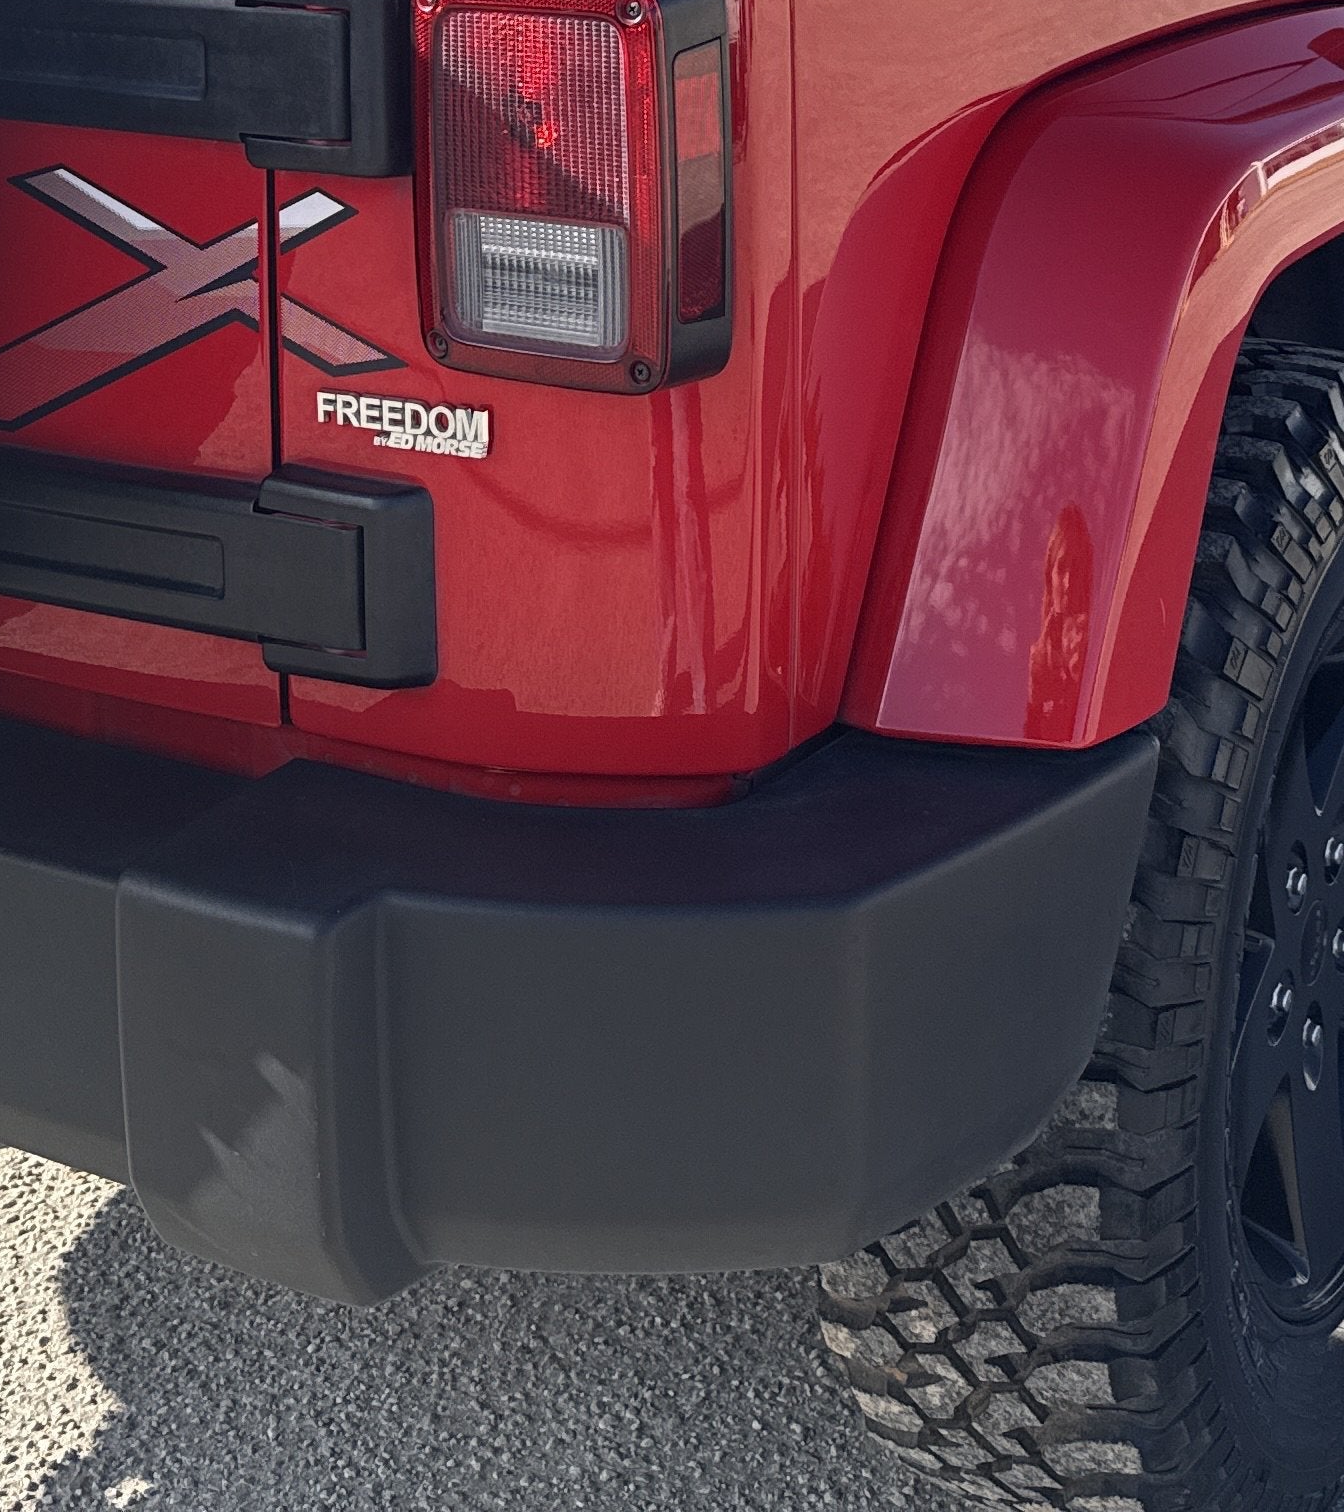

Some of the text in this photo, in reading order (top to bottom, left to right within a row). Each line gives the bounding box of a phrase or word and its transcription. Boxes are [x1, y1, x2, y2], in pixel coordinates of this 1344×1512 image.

[316, 390, 490, 444] FREEDOM
[386, 431, 414, 450] ED
[415, 434, 488, 459] MORSE
